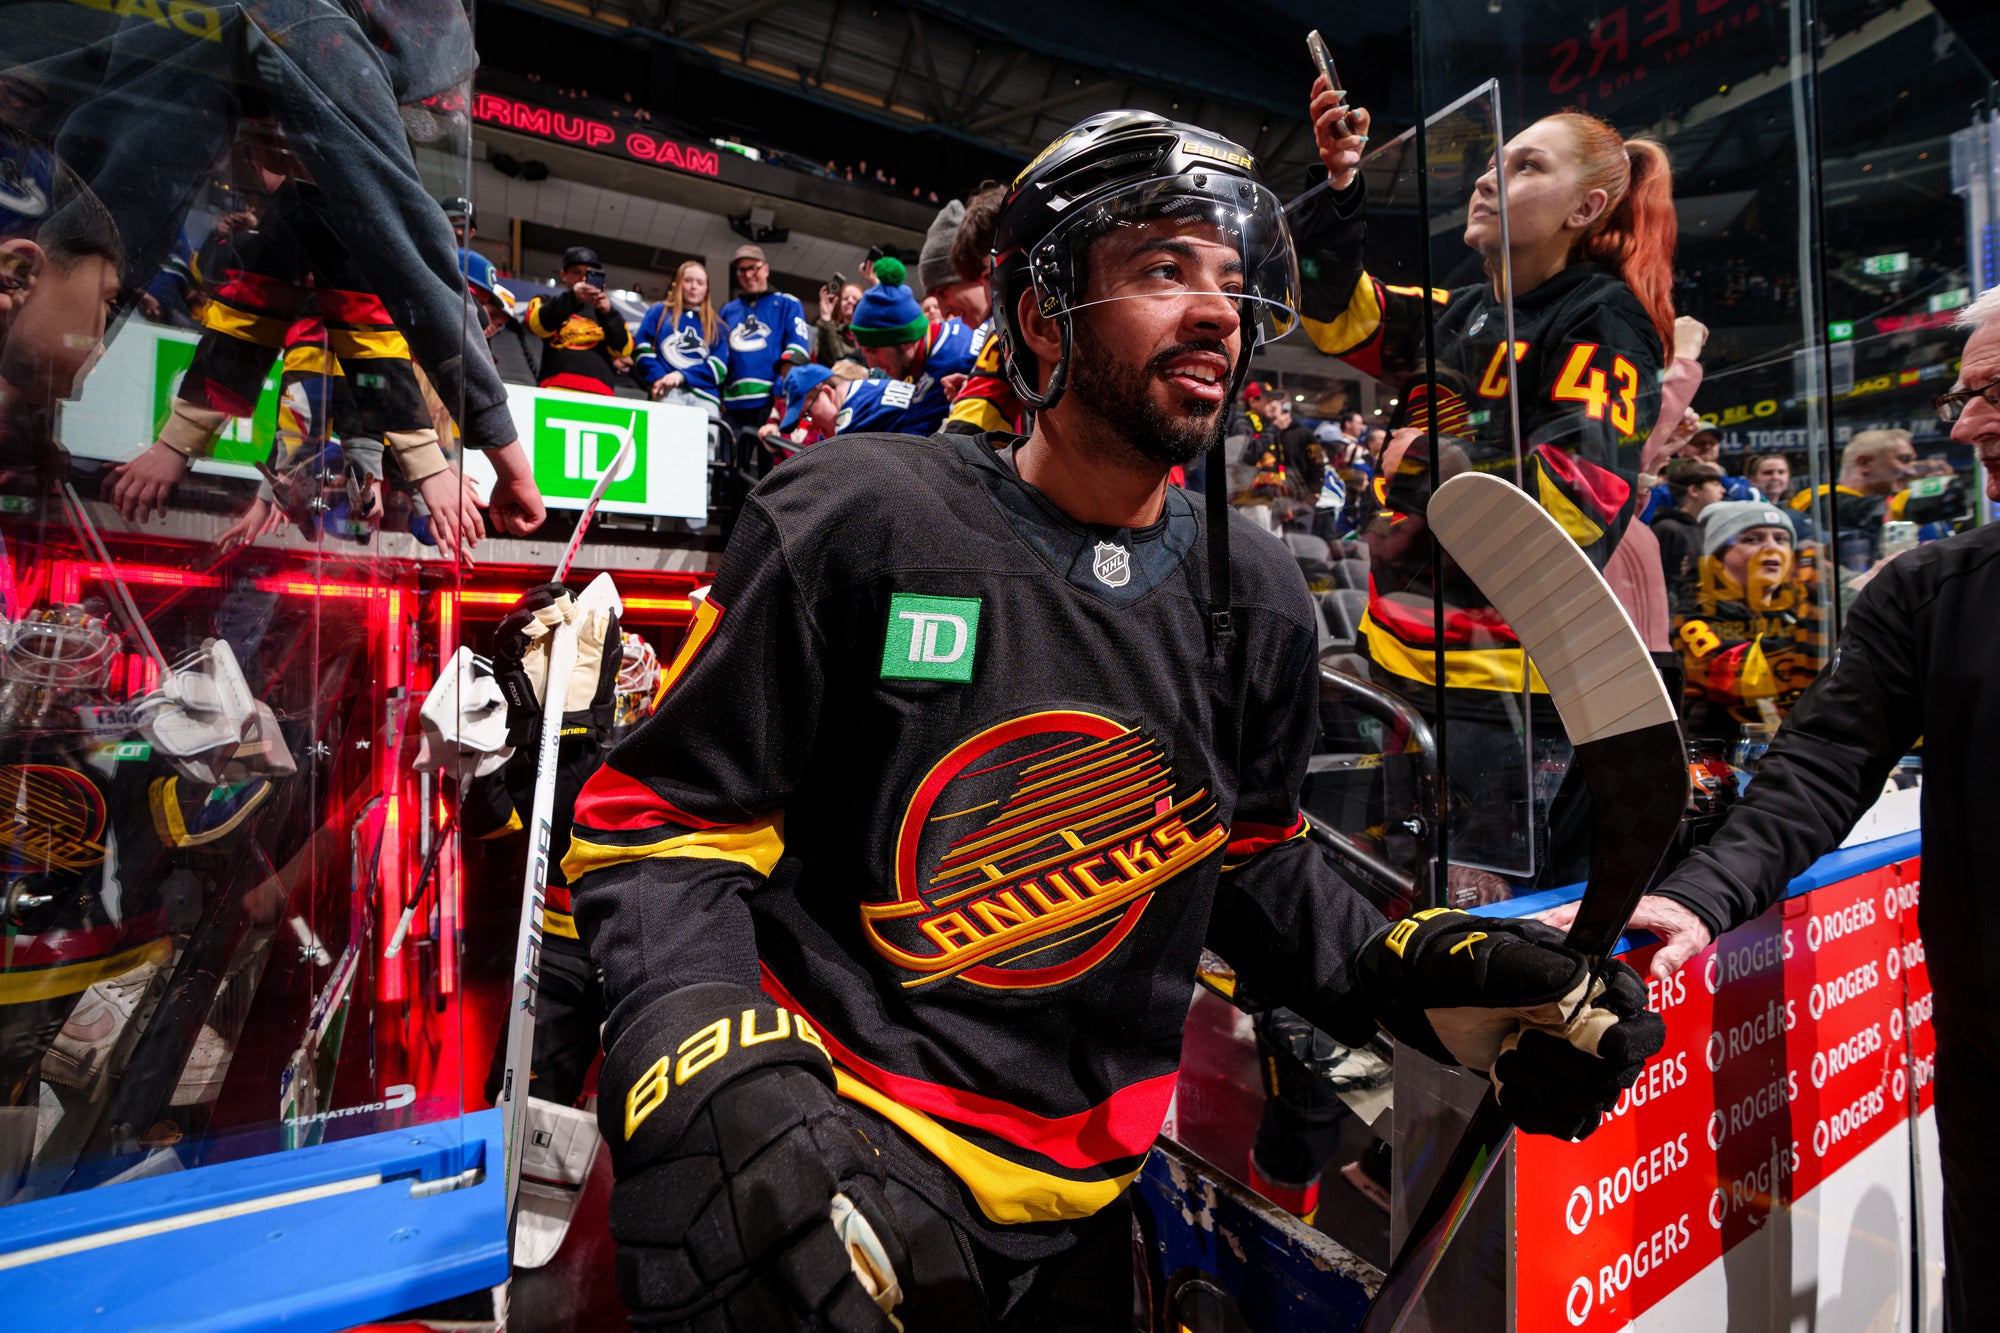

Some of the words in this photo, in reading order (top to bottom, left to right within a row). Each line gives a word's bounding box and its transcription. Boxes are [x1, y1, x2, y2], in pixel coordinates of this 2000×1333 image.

[626, 132, 719, 177] CAM
[1552, 343, 1638, 436] 43
[546, 417, 637, 483] TD
[1102, 555, 1124, 576] NHL
[899, 611, 968, 664] TD
[1824, 897, 1876, 943] ROGERS
[1728, 929, 1794, 983] ROGERS
[1826, 960, 1879, 1009] ROGERS
[1828, 1022, 1881, 1077] ROGERS
[1731, 1070, 1799, 1134] ROGERS
[1831, 1085, 1884, 1144] ROGERS
[1598, 1132, 1689, 1216] ROGERS
[1599, 1213, 1690, 1305] ROGERS
